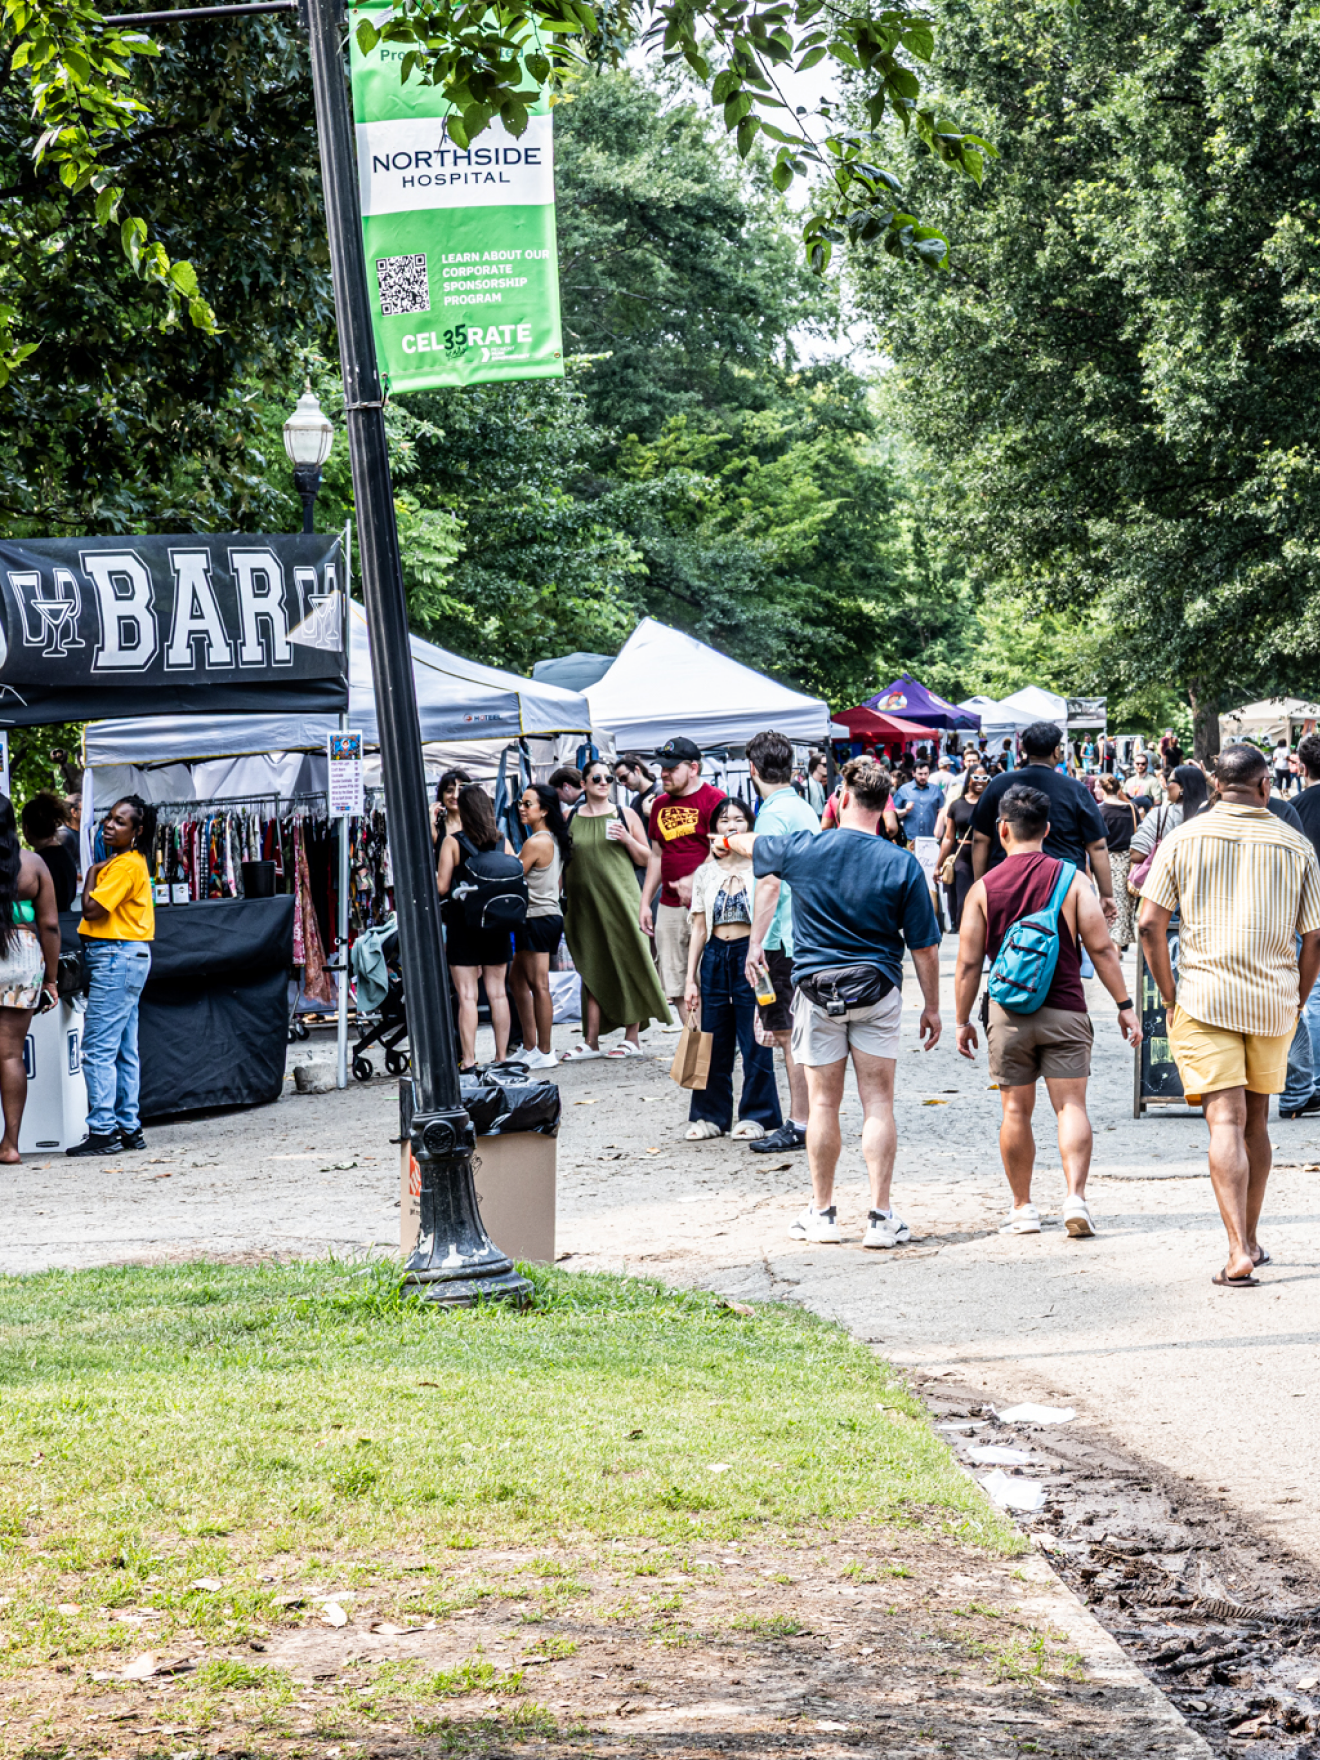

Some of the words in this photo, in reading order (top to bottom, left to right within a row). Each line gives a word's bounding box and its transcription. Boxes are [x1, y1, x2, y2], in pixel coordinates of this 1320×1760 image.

[372, 147, 542, 173] NORTHSIDE
[402, 171, 511, 188] HOSPITAL
[441, 252, 480, 264] LEARN
[482, 250, 522, 261] ABOUT
[524, 249, 550, 260] OUR
[442, 264, 513, 278] CORPORATE
[443, 277, 528, 292] SPONSORSHIP
[443, 292, 502, 306] PROGRAM
[78, 547, 294, 673] BAR
